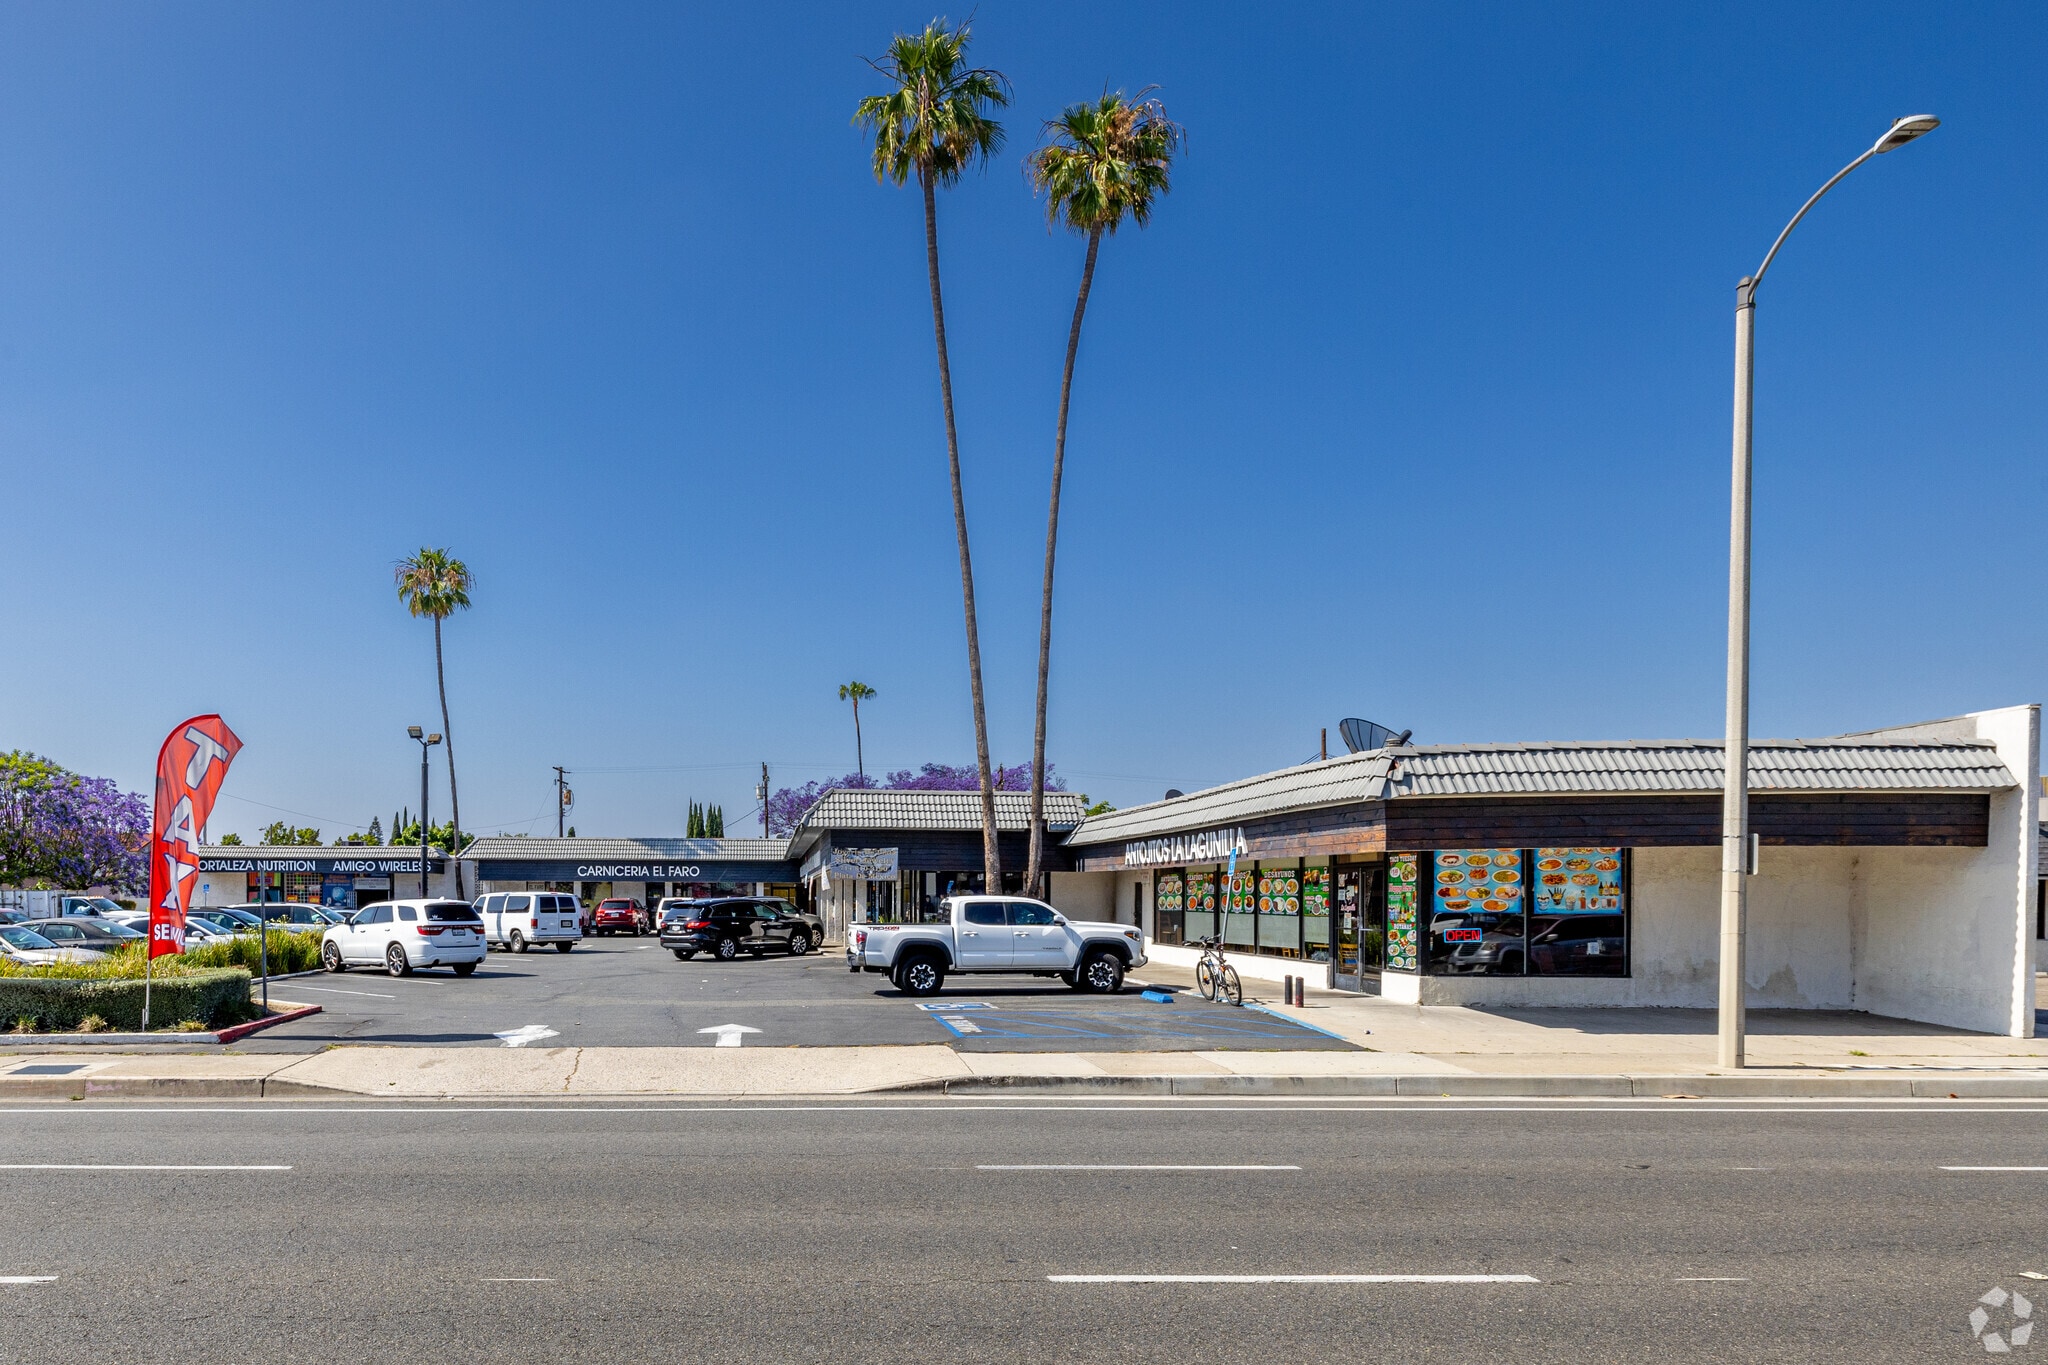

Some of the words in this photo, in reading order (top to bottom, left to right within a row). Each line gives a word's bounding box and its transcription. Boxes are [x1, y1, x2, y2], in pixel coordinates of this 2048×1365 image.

[161, 726, 229, 915] TAX
[1125, 838, 1171, 865] ANTOJITOS
[1171, 837, 1185, 861] LA
[1185, 827, 1248, 860] LAGUNILLA
[199, 860, 254, 871] ORTALEZA
[257, 860, 316, 871] NUTRITION
[332, 860, 376, 872] AMIGO
[577, 866, 649, 877] CARNICERIA
[653, 866, 665, 877] EL
[668, 866, 700, 877] FARO
[1446, 930, 1480, 941] OPEN
